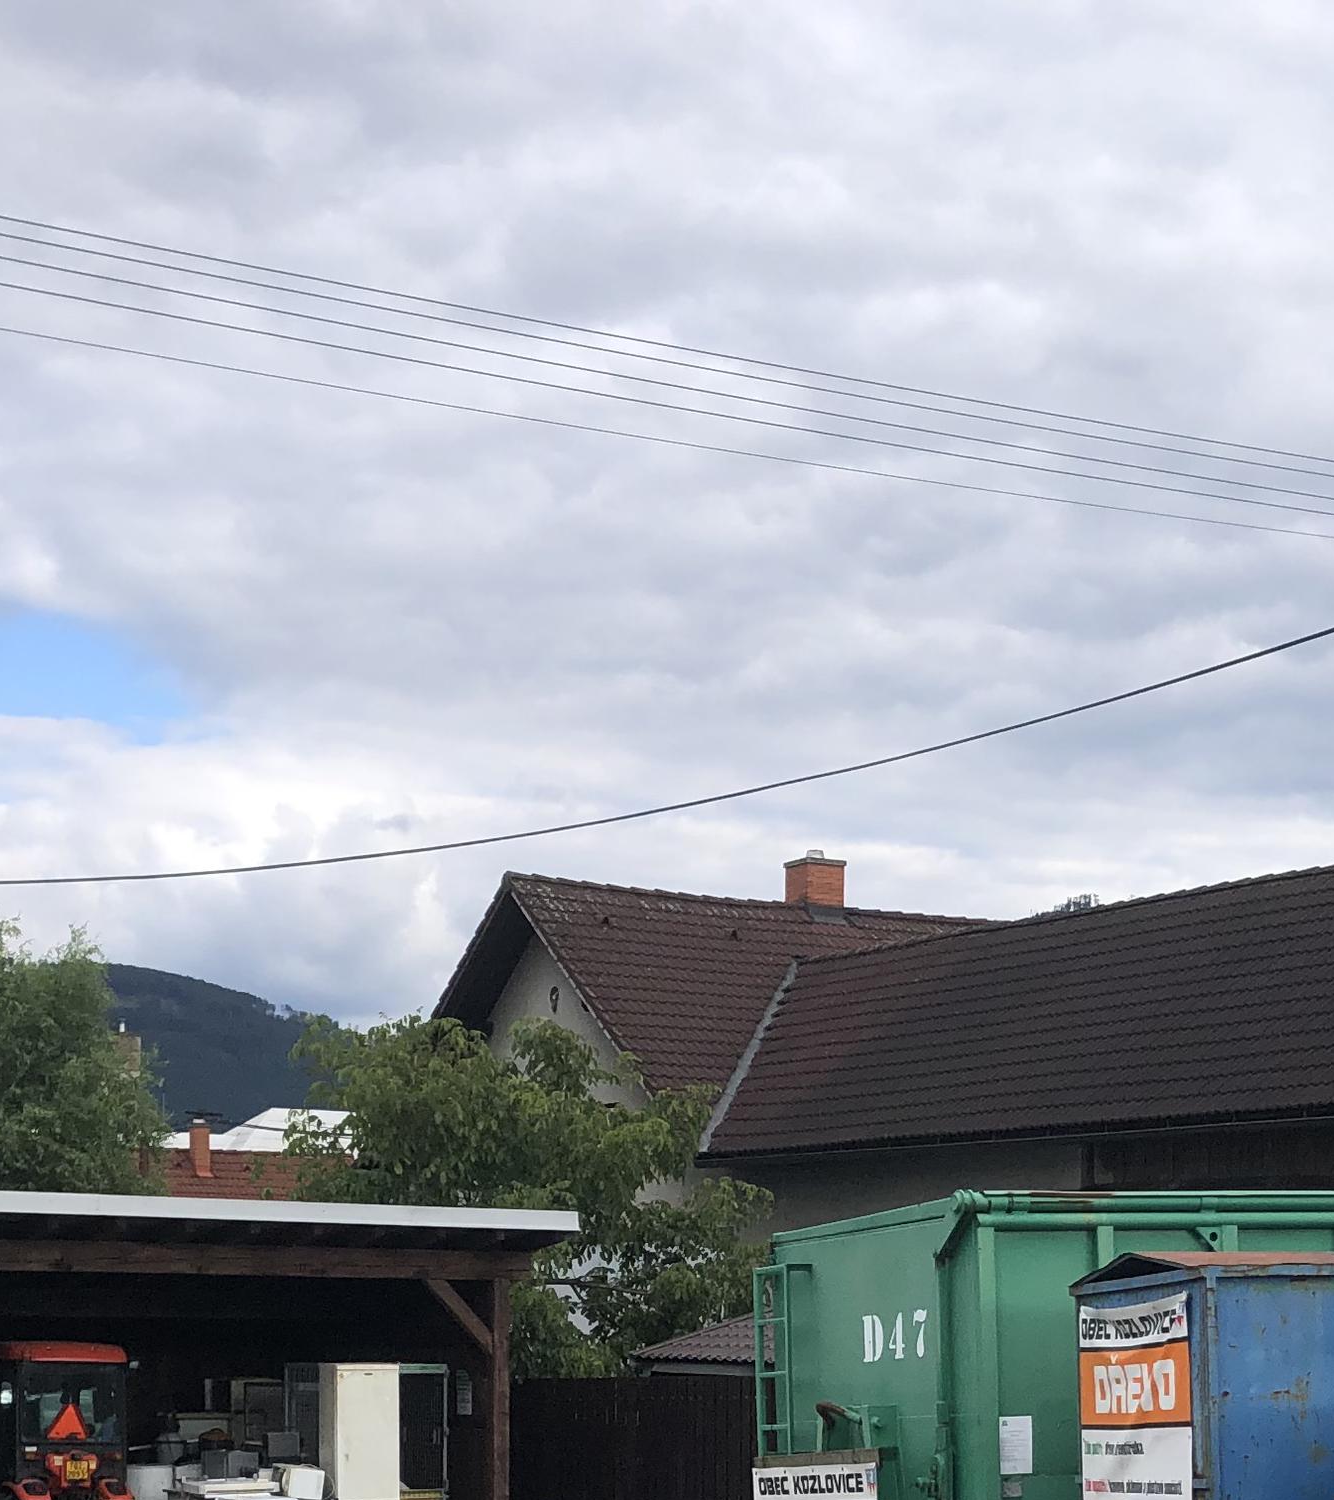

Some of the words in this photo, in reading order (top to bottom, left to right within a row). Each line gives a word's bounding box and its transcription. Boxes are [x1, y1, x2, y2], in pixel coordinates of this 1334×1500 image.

[862, 1308, 927, 1362] D47
[1081, 1317, 1111, 1340] OBEC
[758, 1476, 790, 1496] OBEC
[793, 1473, 864, 1495] KOZLOVICE
